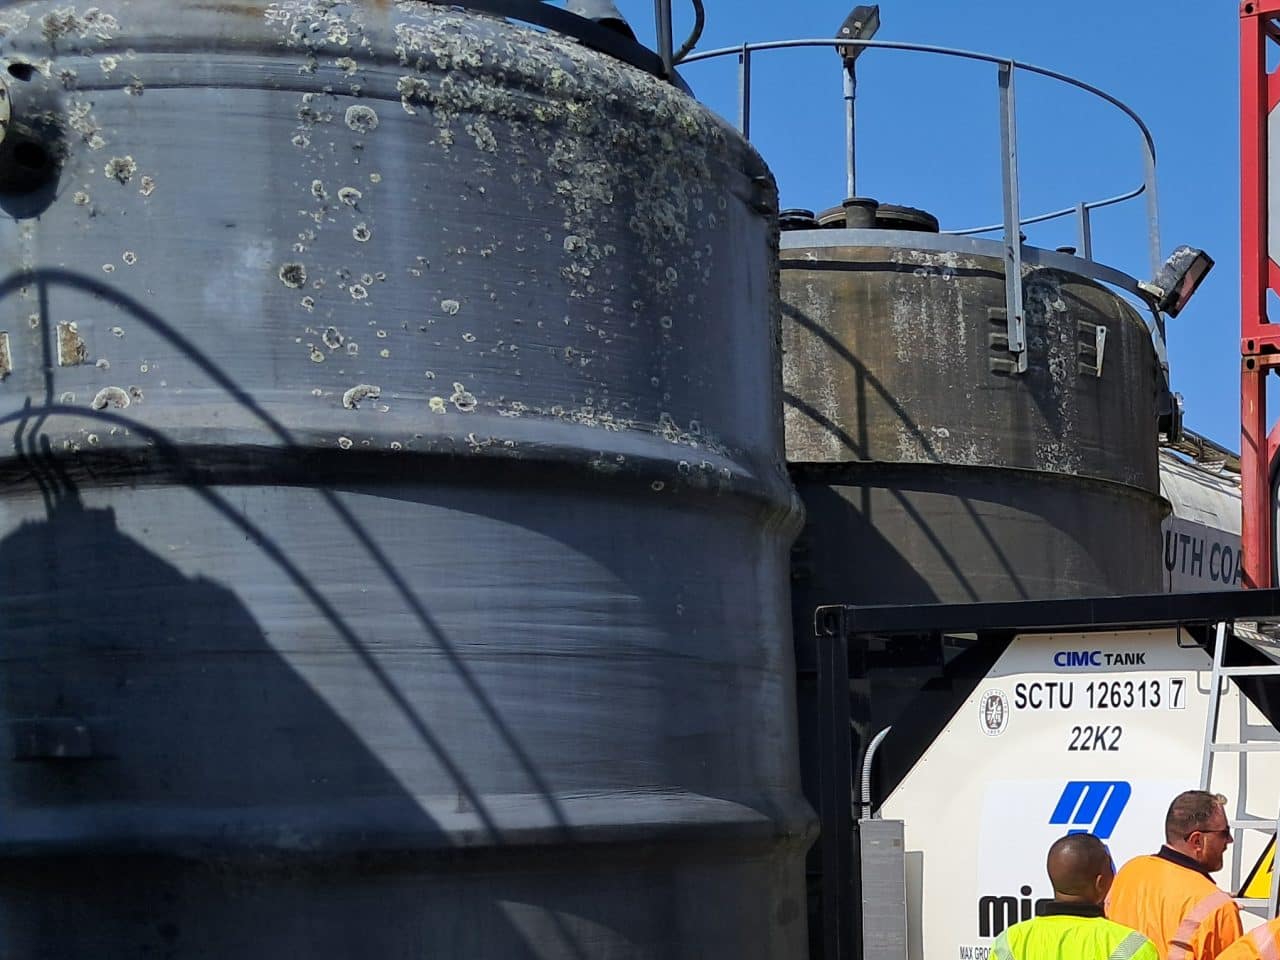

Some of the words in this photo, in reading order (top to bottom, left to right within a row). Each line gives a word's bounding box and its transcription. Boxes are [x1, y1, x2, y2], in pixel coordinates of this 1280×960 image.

[1165, 530, 1204, 577] UTH
[1053, 651, 1102, 667] CIMC
[1104, 653, 1146, 666] TANK
[1015, 681, 1074, 709] SCTU
[1086, 680, 1161, 709] 126313
[1171, 679, 1184, 708] 7
[1067, 725, 1123, 751] 22K2
[960, 946, 973, 960] MAX
[975, 947, 991, 960] GRO
